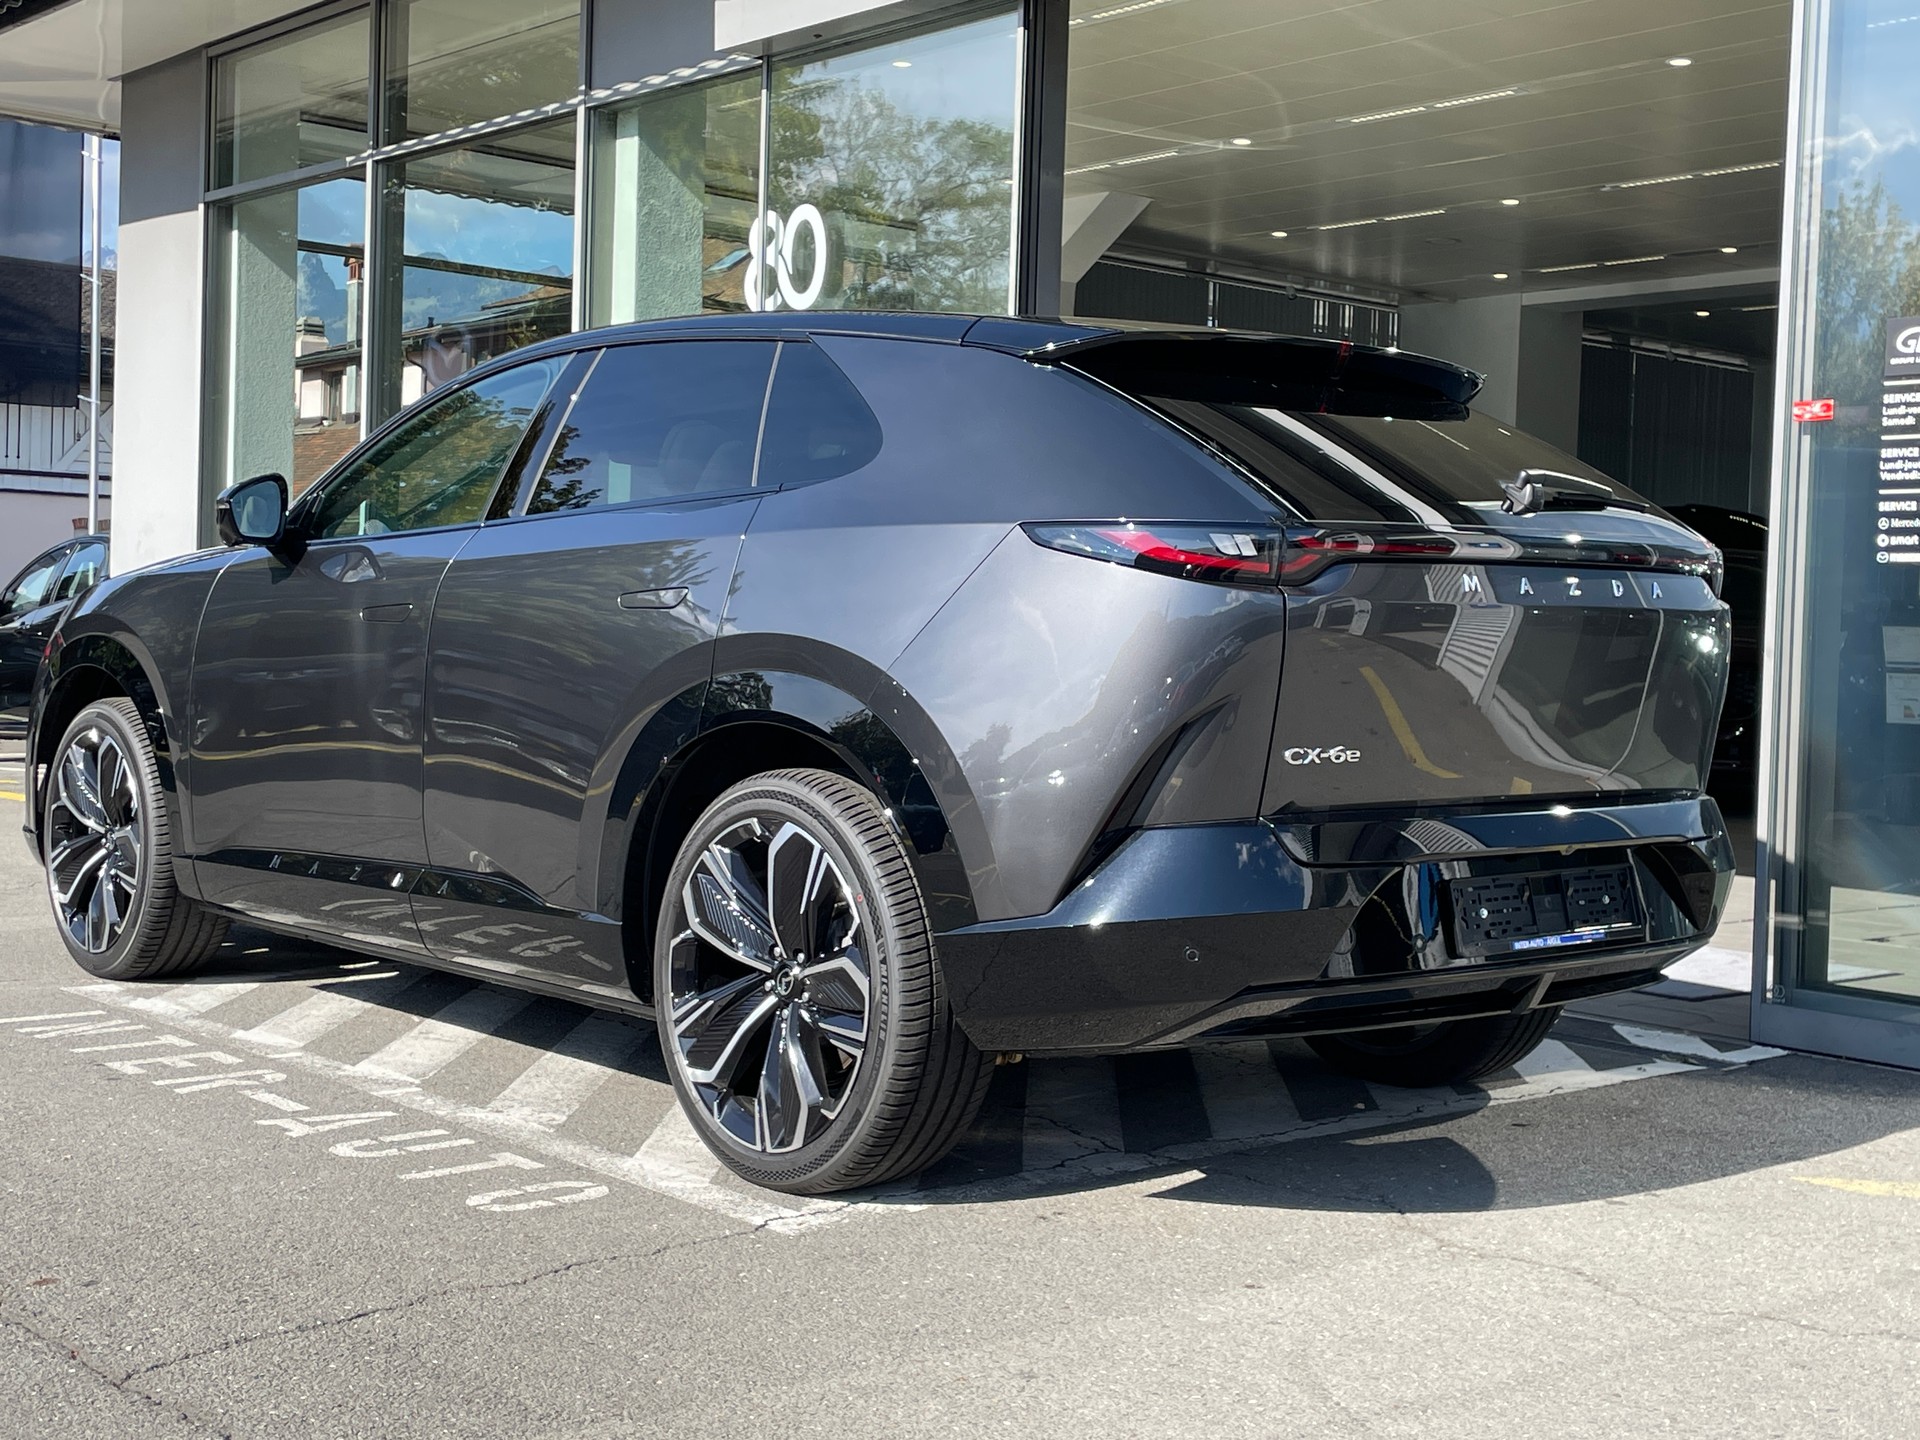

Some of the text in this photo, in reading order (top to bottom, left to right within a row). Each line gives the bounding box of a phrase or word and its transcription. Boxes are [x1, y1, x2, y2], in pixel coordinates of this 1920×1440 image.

[743, 203, 827, 312] 80
[1881, 447, 1919, 458] SERVICE
[1878, 500, 1917, 512] SERVICE
[1890, 534, 1919, 546] smart
[1461, 573, 1664, 600] MAZDA
[1283, 745, 1361, 765] CX-6e
[879, 963, 889, 1041] MICHELIN
[0, 1009, 611, 1213] INTER-AUTO
